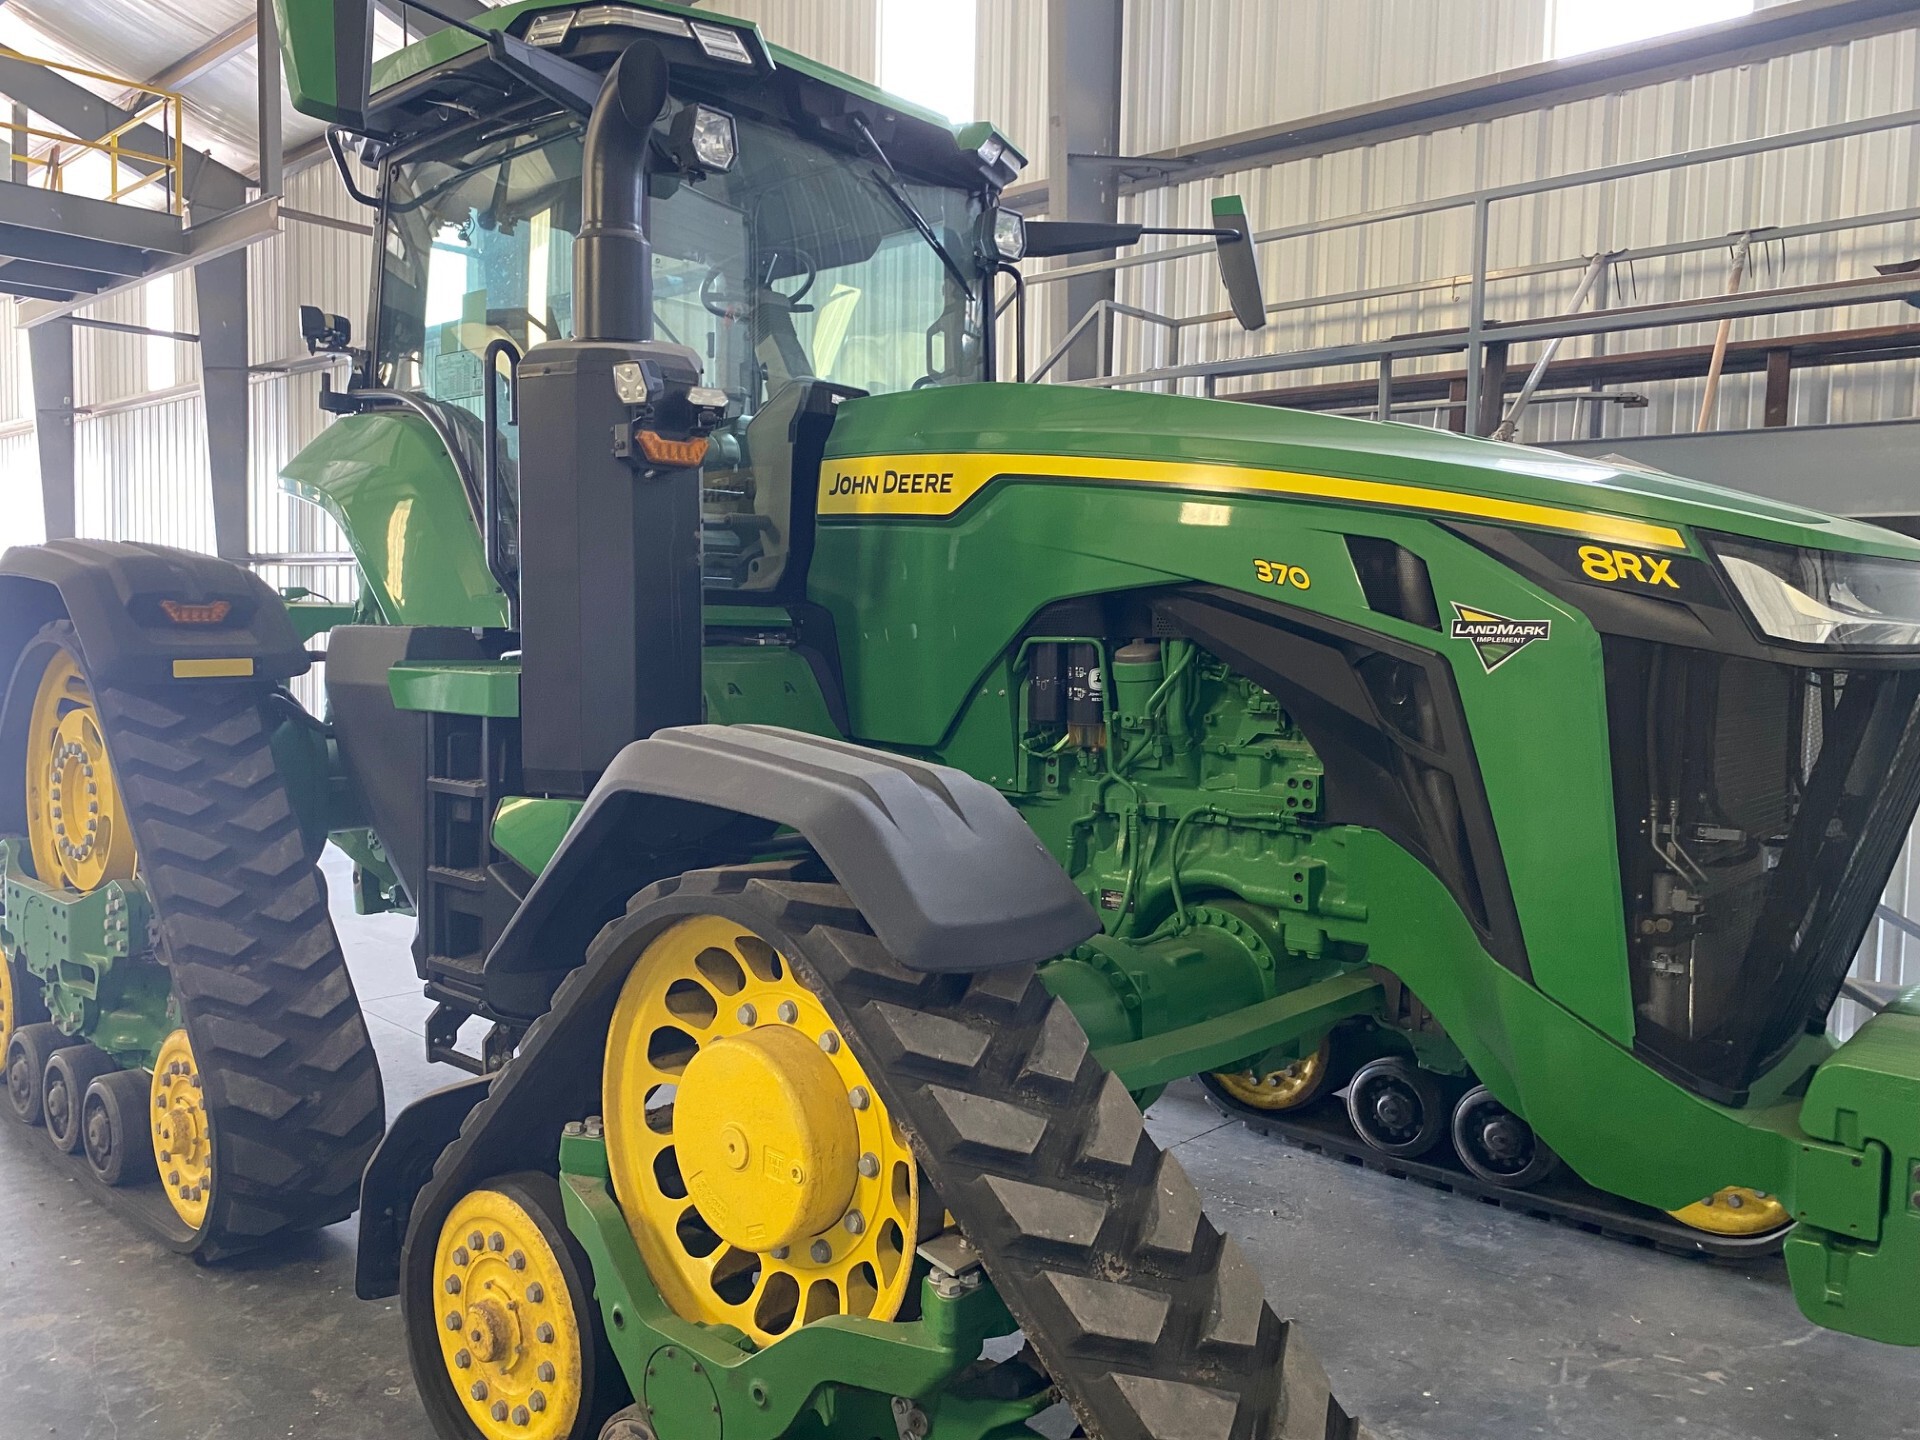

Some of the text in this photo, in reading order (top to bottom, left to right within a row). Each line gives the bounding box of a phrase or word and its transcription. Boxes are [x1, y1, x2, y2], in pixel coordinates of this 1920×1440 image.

[829, 470, 954, 495] JOHN DEERE
[1253, 559, 1311, 590] 370
[1578, 545, 1680, 589] 8RX
[1476, 636, 1526, 644] IMPLEMENT
